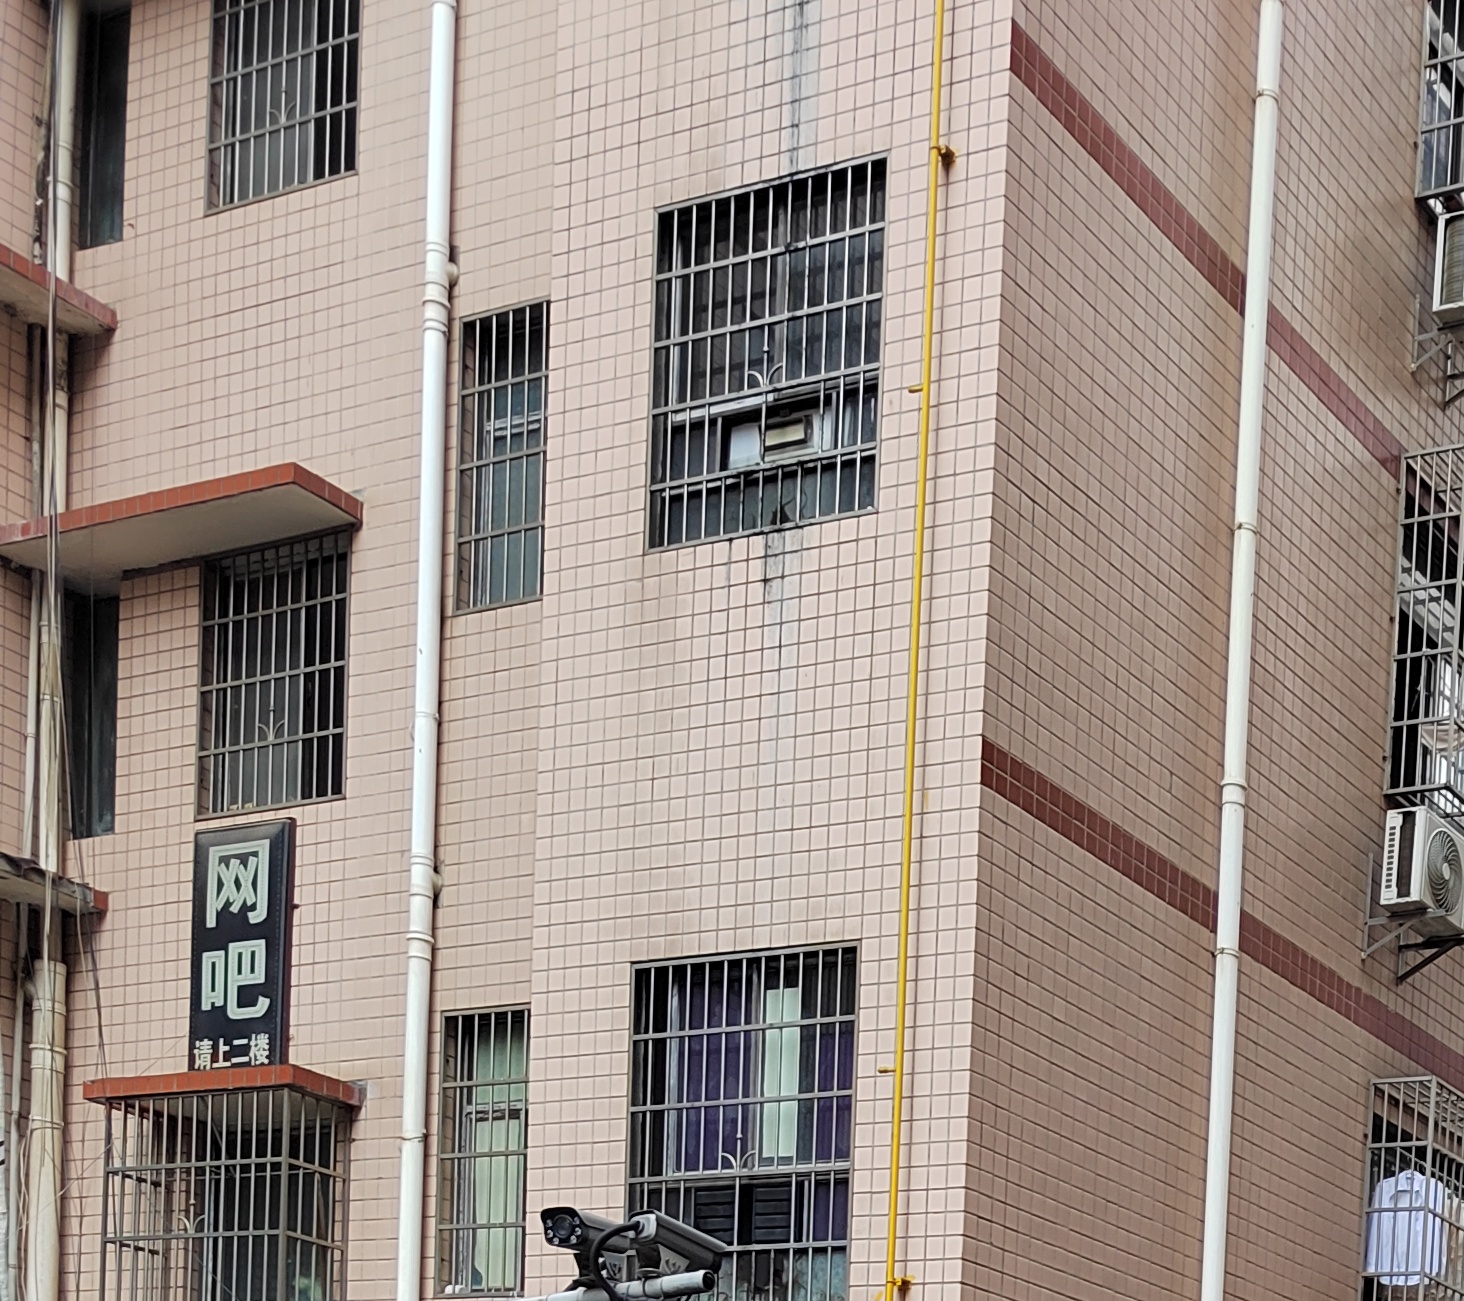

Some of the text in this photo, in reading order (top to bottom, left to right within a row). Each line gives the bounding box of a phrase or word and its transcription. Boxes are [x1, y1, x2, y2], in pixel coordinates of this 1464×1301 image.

[201, 838, 271, 1020] 网吧
[193, 1033, 270, 1071] 请上二楼
